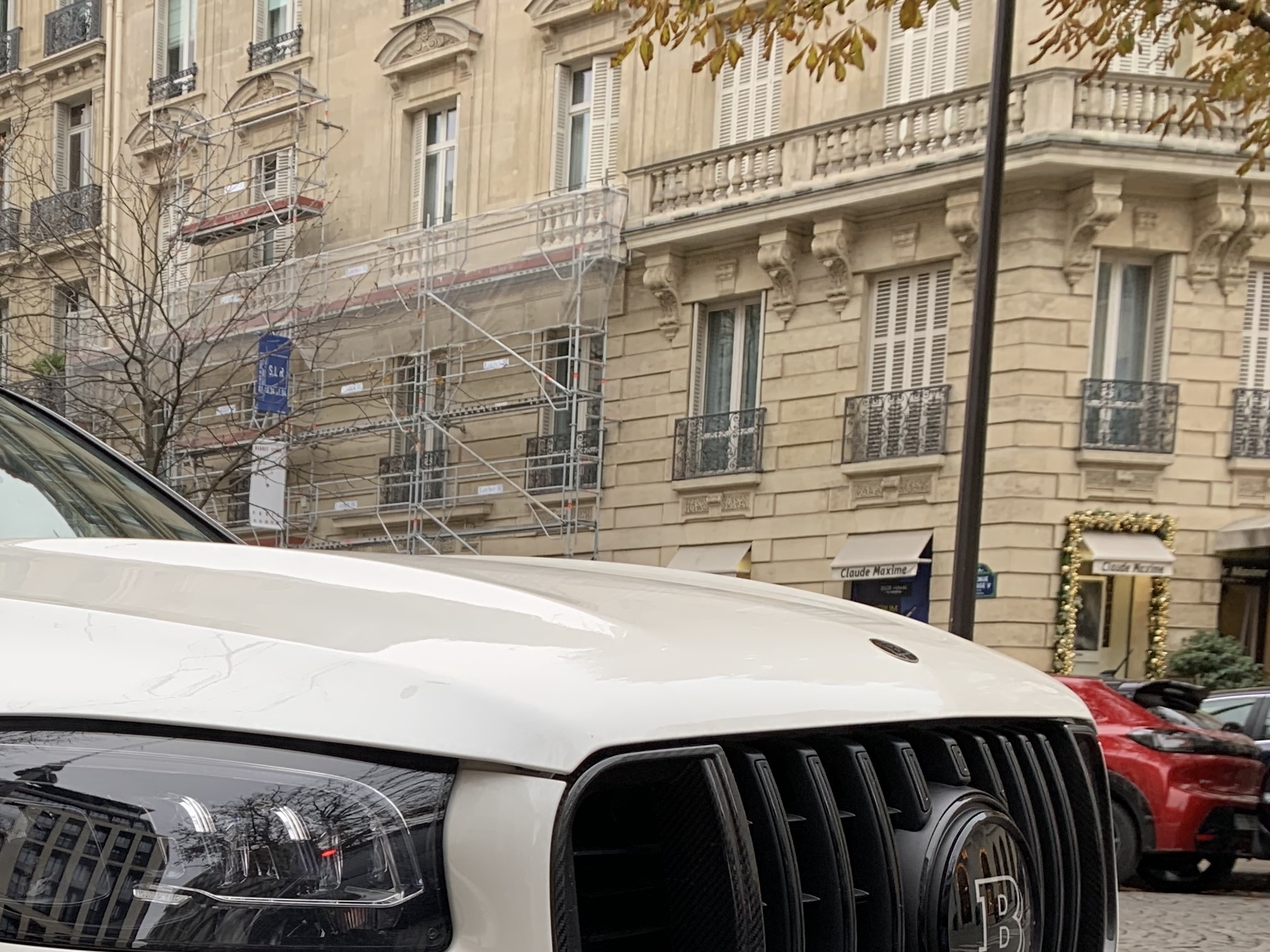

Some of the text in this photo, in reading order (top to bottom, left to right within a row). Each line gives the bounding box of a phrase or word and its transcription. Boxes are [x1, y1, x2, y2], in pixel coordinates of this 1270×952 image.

[840, 564, 907, 579] Claude Maxime
[1101, 561, 1165, 574] Claude Maxime
